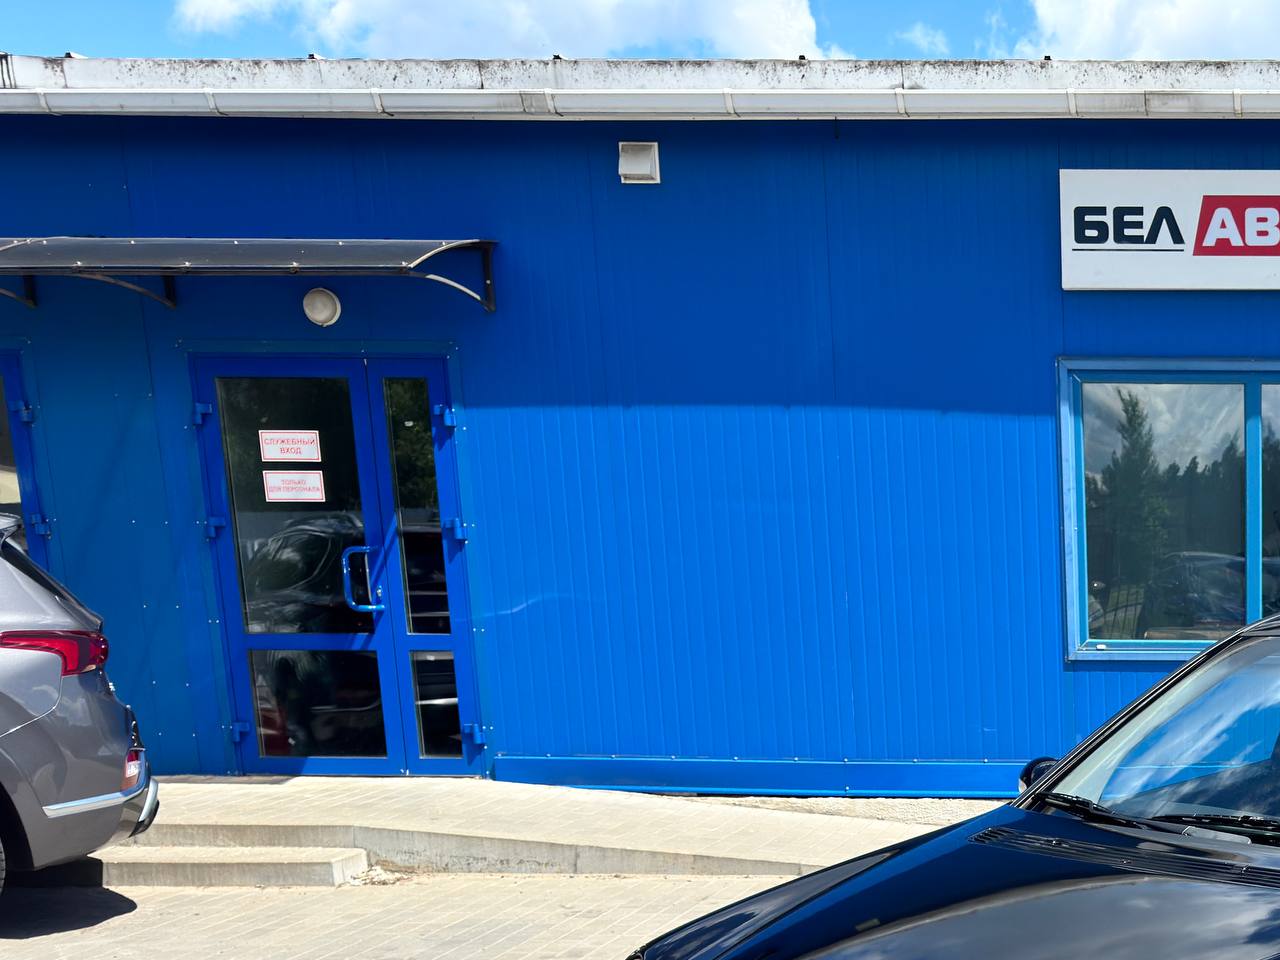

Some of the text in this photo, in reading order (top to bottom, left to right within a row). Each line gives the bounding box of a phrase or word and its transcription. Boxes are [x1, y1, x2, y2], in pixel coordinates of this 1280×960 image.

[1073, 206, 1186, 245] БЕЛ
[264, 437, 315, 446] СЛУЖЕБНЫЙ
[279, 447, 302, 455] ВХОД
